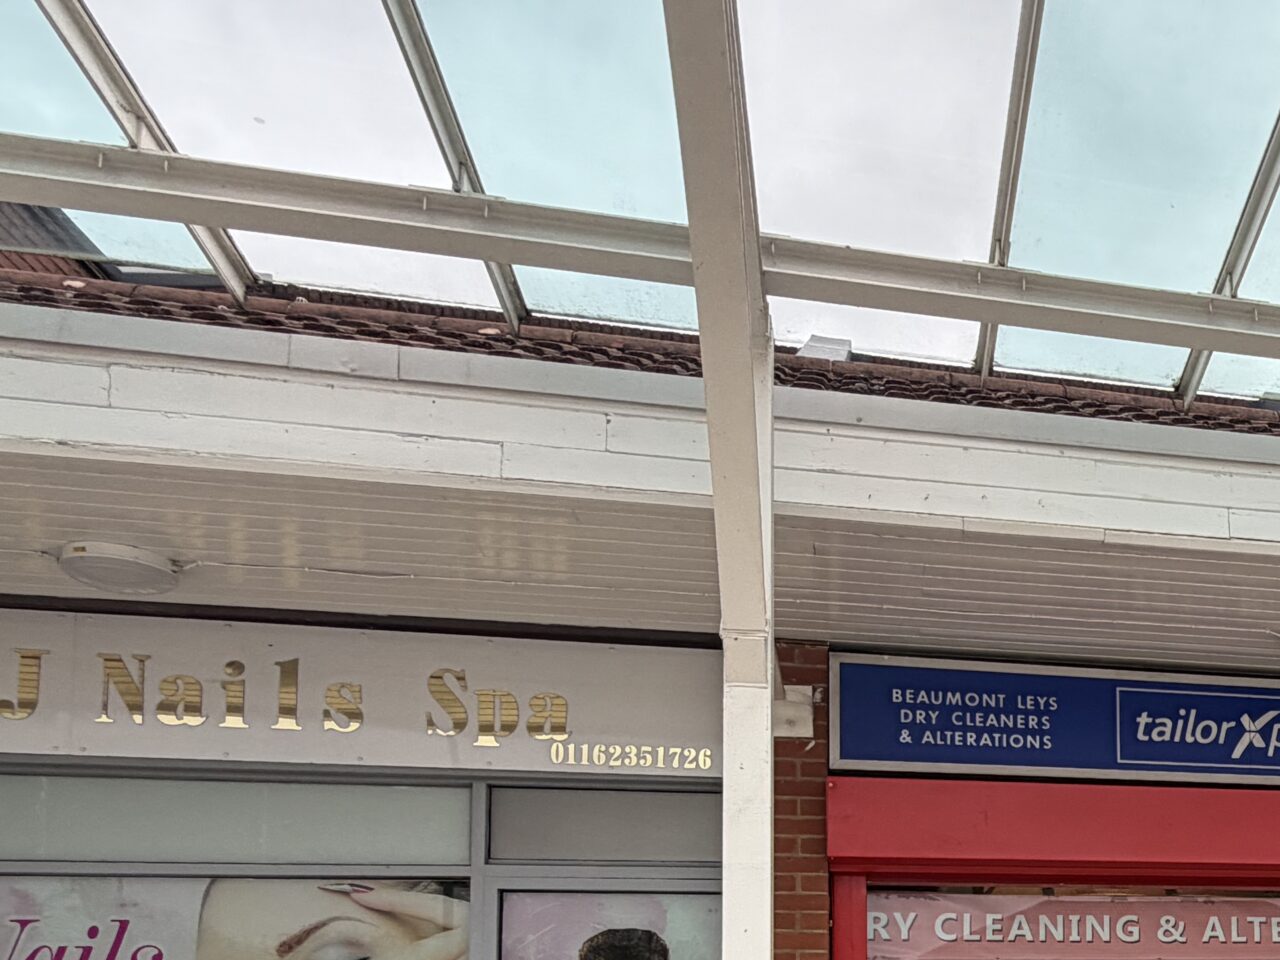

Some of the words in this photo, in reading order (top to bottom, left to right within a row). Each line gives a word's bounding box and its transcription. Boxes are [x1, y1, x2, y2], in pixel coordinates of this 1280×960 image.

[0, 648, 50, 720] J
[95, 652, 364, 733] Nails
[426, 667, 573, 747] Spa
[892, 688, 1006, 708] BEAUMONT
[1017, 695, 1058, 711] LEYS
[900, 709, 939, 724] DRY
[951, 712, 1051, 730] CLEANERS
[899, 729, 912, 744] &
[922, 731, 1052, 749] ALTERATIONS
[550, 741, 711, 769] 01162351726
[934, 913, 1141, 943] CLEANING
[1157, 915, 1187, 944] &
